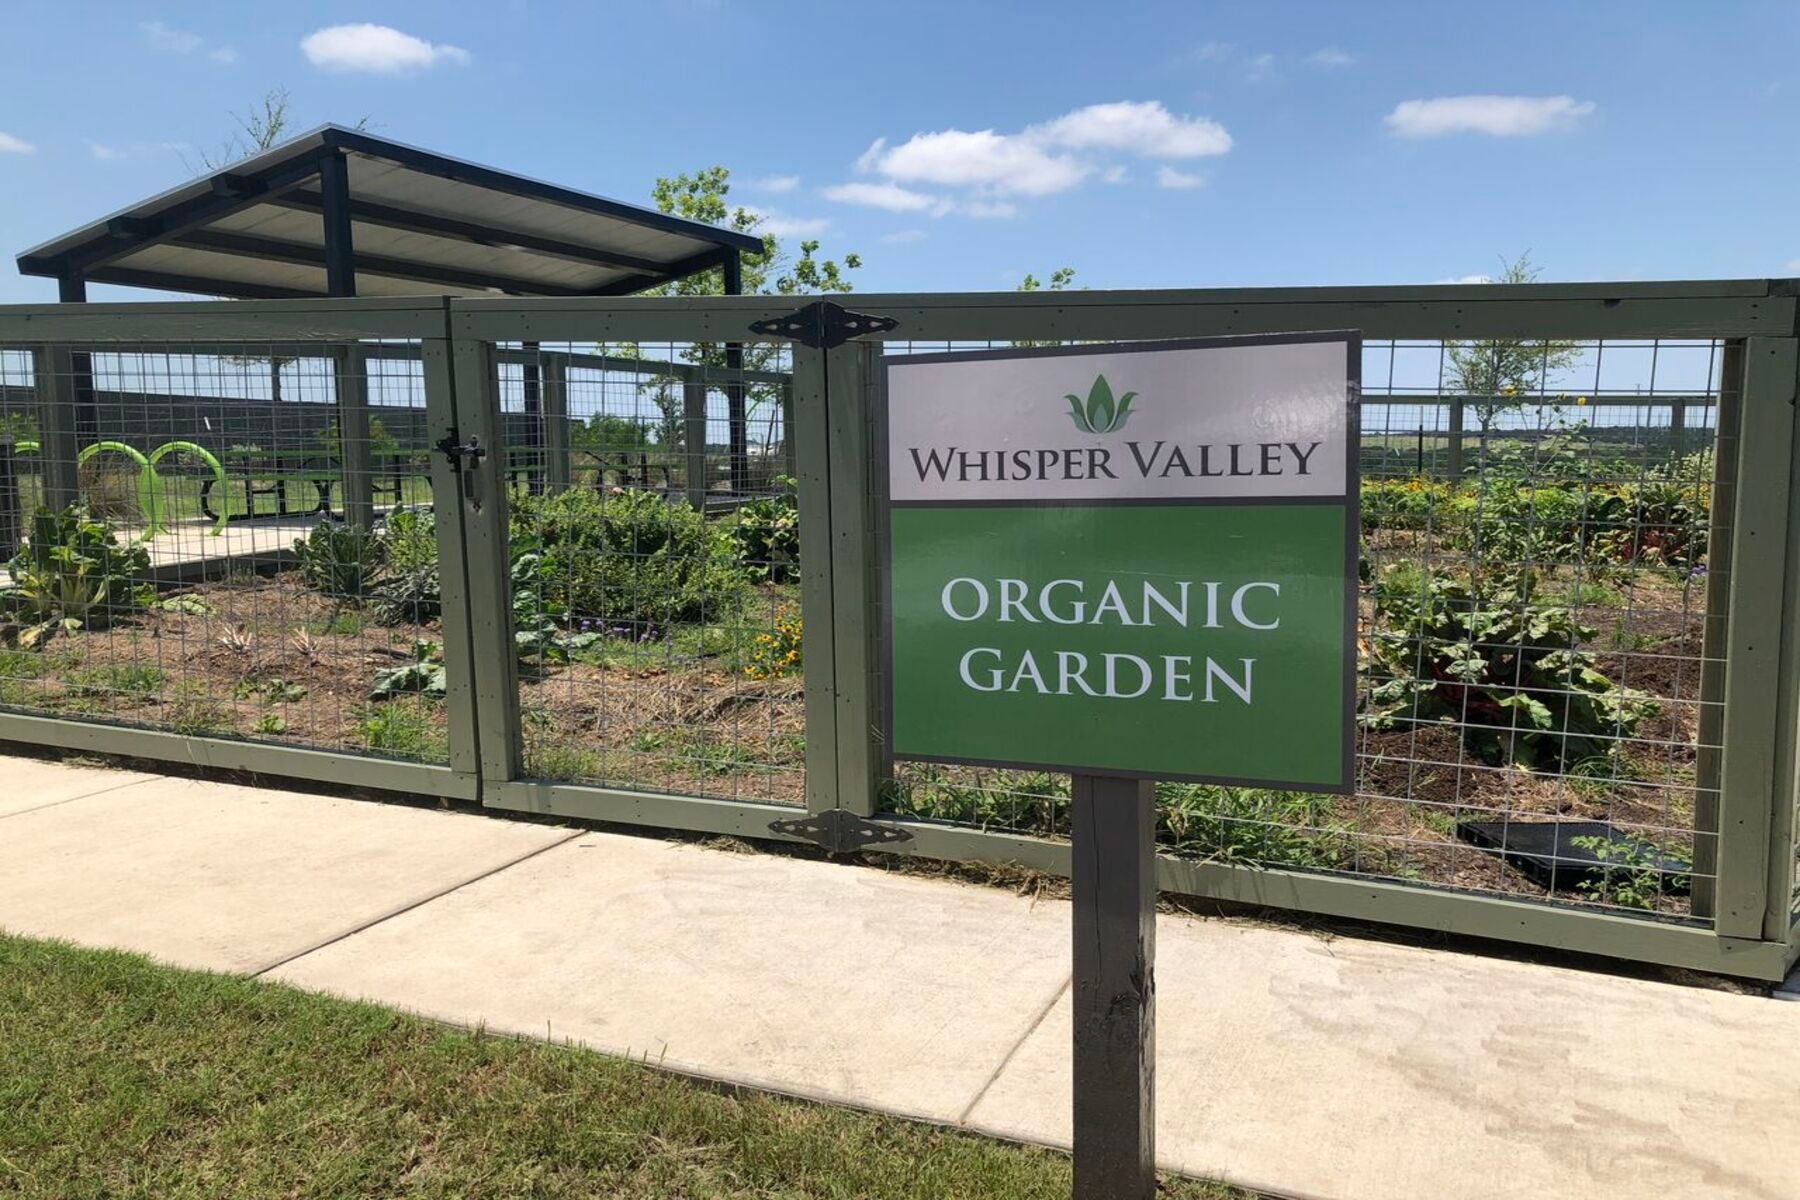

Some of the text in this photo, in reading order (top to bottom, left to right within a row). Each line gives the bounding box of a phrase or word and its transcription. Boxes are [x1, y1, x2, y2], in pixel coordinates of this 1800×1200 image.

[909, 440, 1322, 483] WHISPER VALLEY
[941, 577, 1280, 630] ORGANIC
[959, 647, 1257, 705] GARDEN
